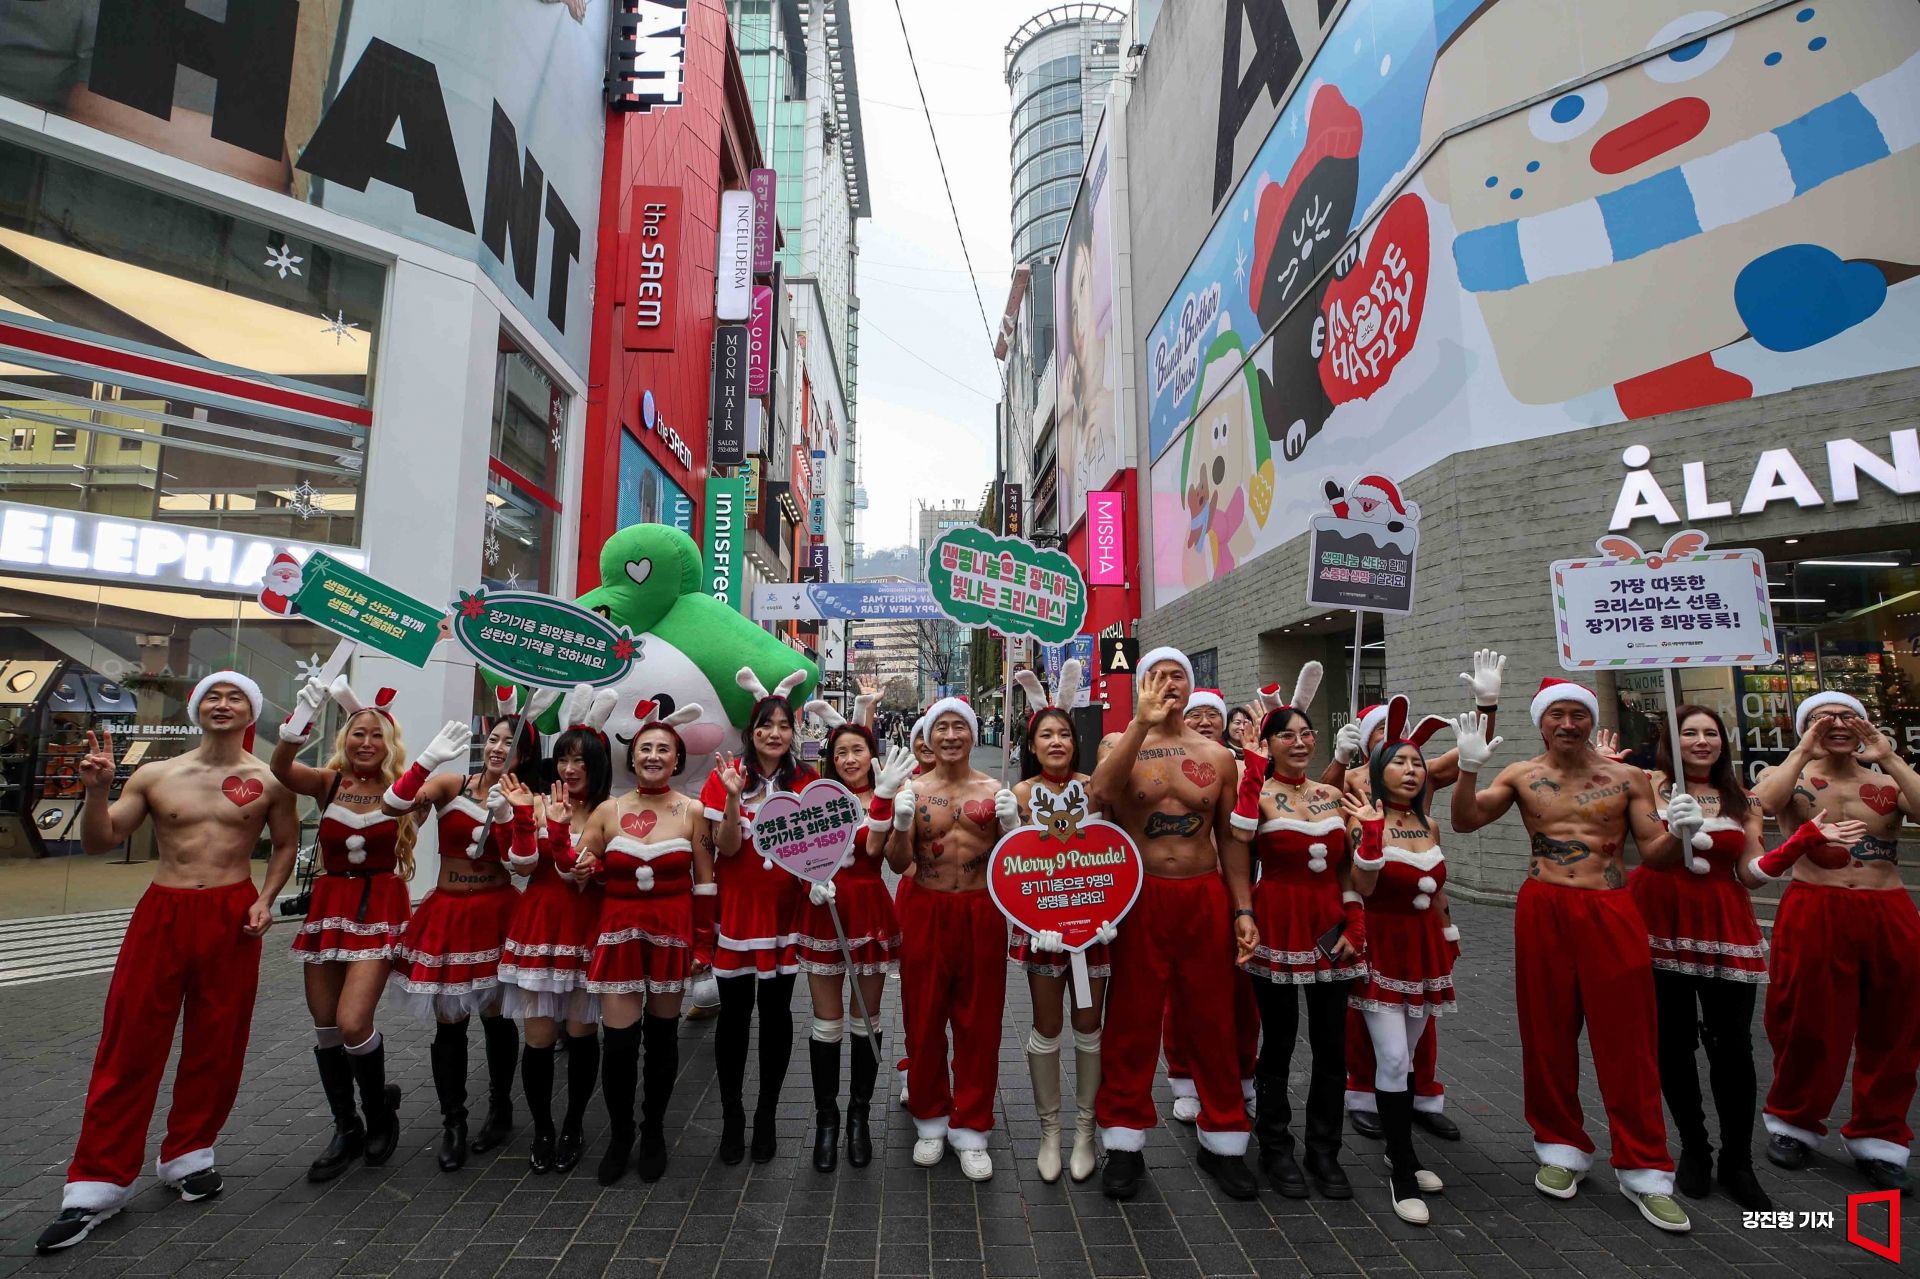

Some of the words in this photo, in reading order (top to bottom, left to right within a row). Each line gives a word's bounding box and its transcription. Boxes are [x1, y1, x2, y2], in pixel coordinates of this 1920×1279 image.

[643, 203, 667, 237] the
[734, 205, 749, 289] INCELLDERM
[1332, 271, 1414, 385] HAPPY
[726, 335, 738, 379] MOON
[724, 385, 736, 431] HAIR
[656, 410, 668, 444] the
[1098, 501, 1115, 574] MISSHA
[942, 544, 1027, 587] 생명나눔으로
[1029, 566, 1078, 604] 장식하는
[1319, 567, 1350, 582] 소중한
[1376, 573, 1406, 588] 살려요!
[1320, 551, 1360, 569] 생명나눔
[1361, 556, 1388, 571] 산타와
[1388, 559, 1408, 573] 함께
[953, 574, 997, 608] 빛나는
[998, 585, 1066, 625] 크리스마스!
[1610, 577, 1646, 595] 가장
[1650, 574, 1706, 593] 따뜻한
[322, 579, 369, 607] 생명나눔
[367, 600, 400, 622] 산타와
[400, 614, 428, 634] 함께
[327, 596, 360, 619] 생명을
[359, 612, 408, 641] 선물해요!
[1593, 596, 1682, 615] 크리스마스
[1685, 592, 1729, 611] 선물,
[488, 609, 537, 634] 장기기증
[538, 622, 607, 653] 희망등록으로
[1585, 616, 1655, 635] 장기기증
[1659, 611, 1741, 632] 희망등록!
[480, 626, 518, 647] 성탄의
[518, 636, 555, 658] 기적을
[556, 645, 608, 671] 전하세요!
[108, 724, 140, 734] BLUE
[756, 815, 788, 836] 9명을
[789, 804, 824, 826] 구하는
[825, 796, 855, 813] 약속,
[927, 796, 949, 808] 1589
[758, 829, 805, 851] 장기기증
[806, 808, 858, 836] 희망등록!
[775, 830, 847, 860] 1588-1589
[1389, 826, 1431, 840] Donor
[1003, 853, 1057, 877] Merry
[1056, 852, 1066, 870] 9
[1067, 845, 1127, 868] Parade!
[1020, 878, 1086, 896] 장기기증으로
[1086, 873, 1115, 888] 9명의
[1036, 894, 1070, 910] 생명을
[1070, 890, 1106, 909] 살려요!
